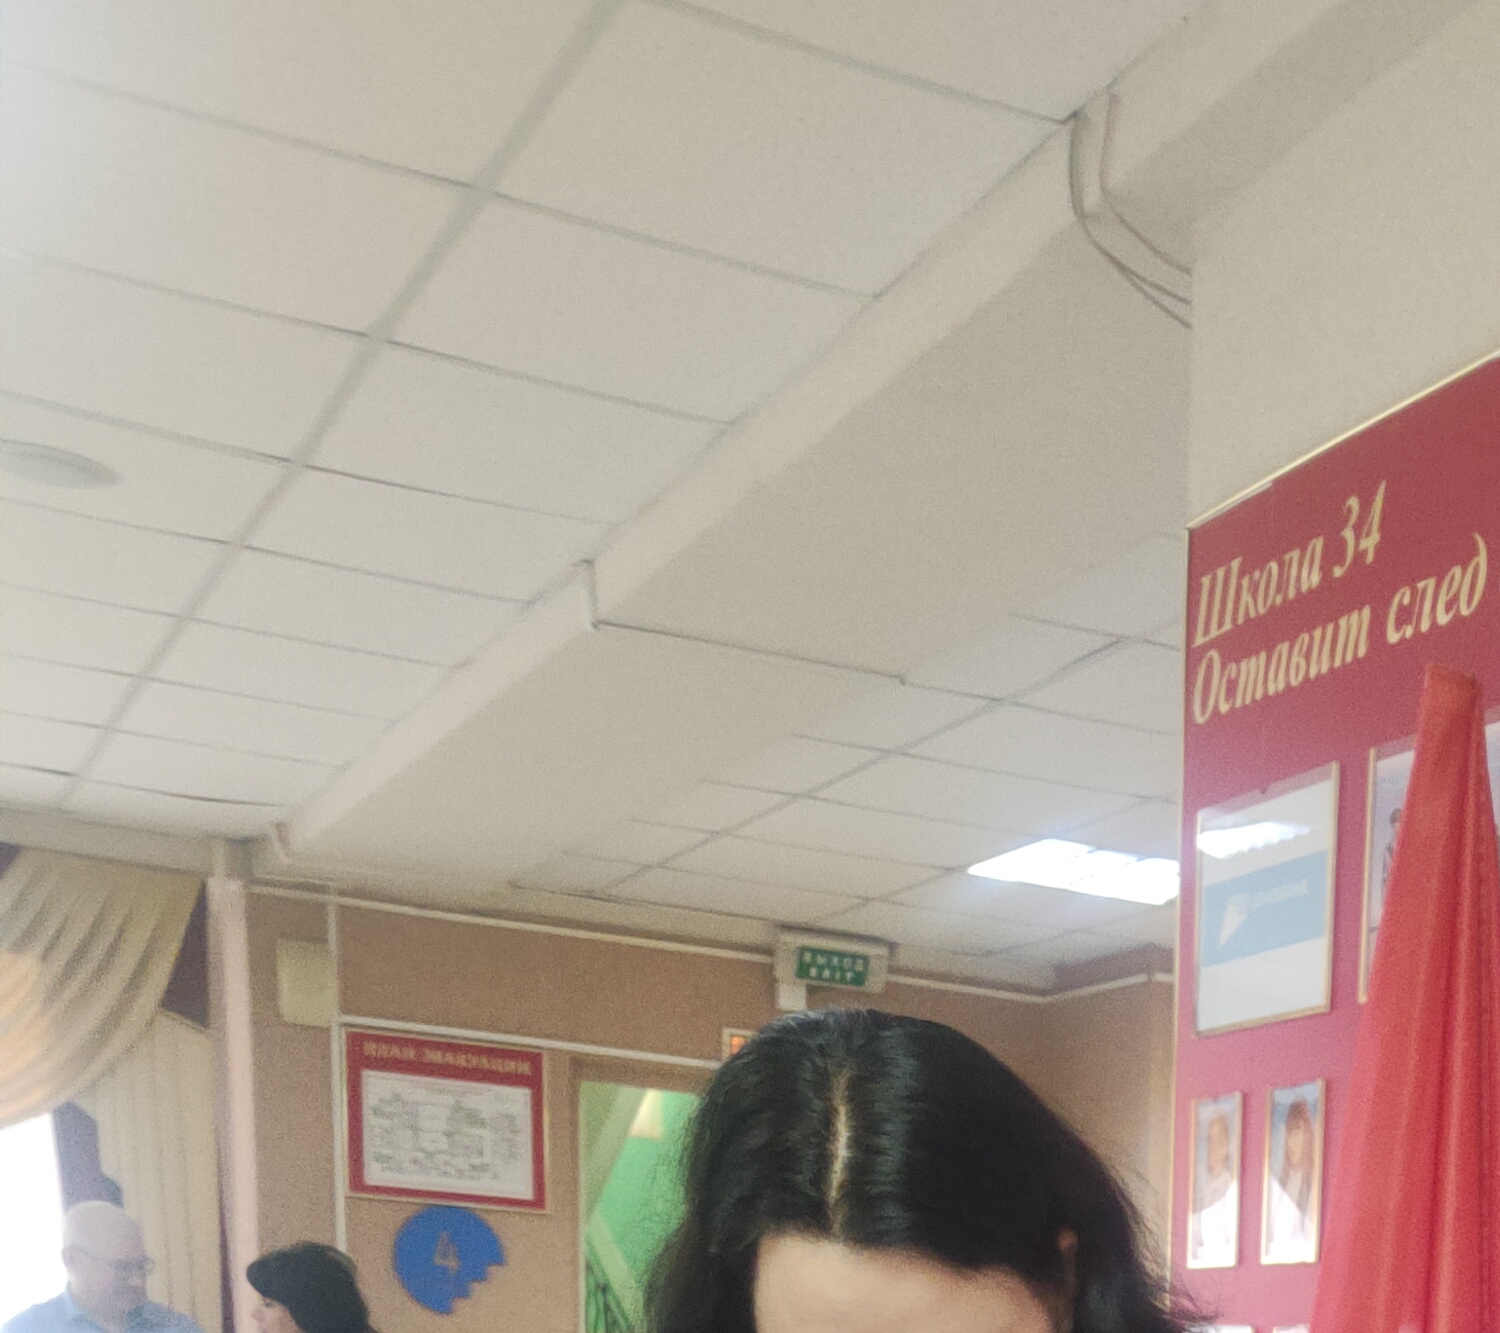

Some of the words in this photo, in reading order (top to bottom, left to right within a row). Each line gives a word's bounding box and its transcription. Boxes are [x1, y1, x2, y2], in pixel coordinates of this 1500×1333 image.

[1191, 555, 1323, 648] Школа
[1332, 480, 1387, 578] 34
[1191, 605, 1373, 725] Оставит
[1386, 532, 1488, 645] след
